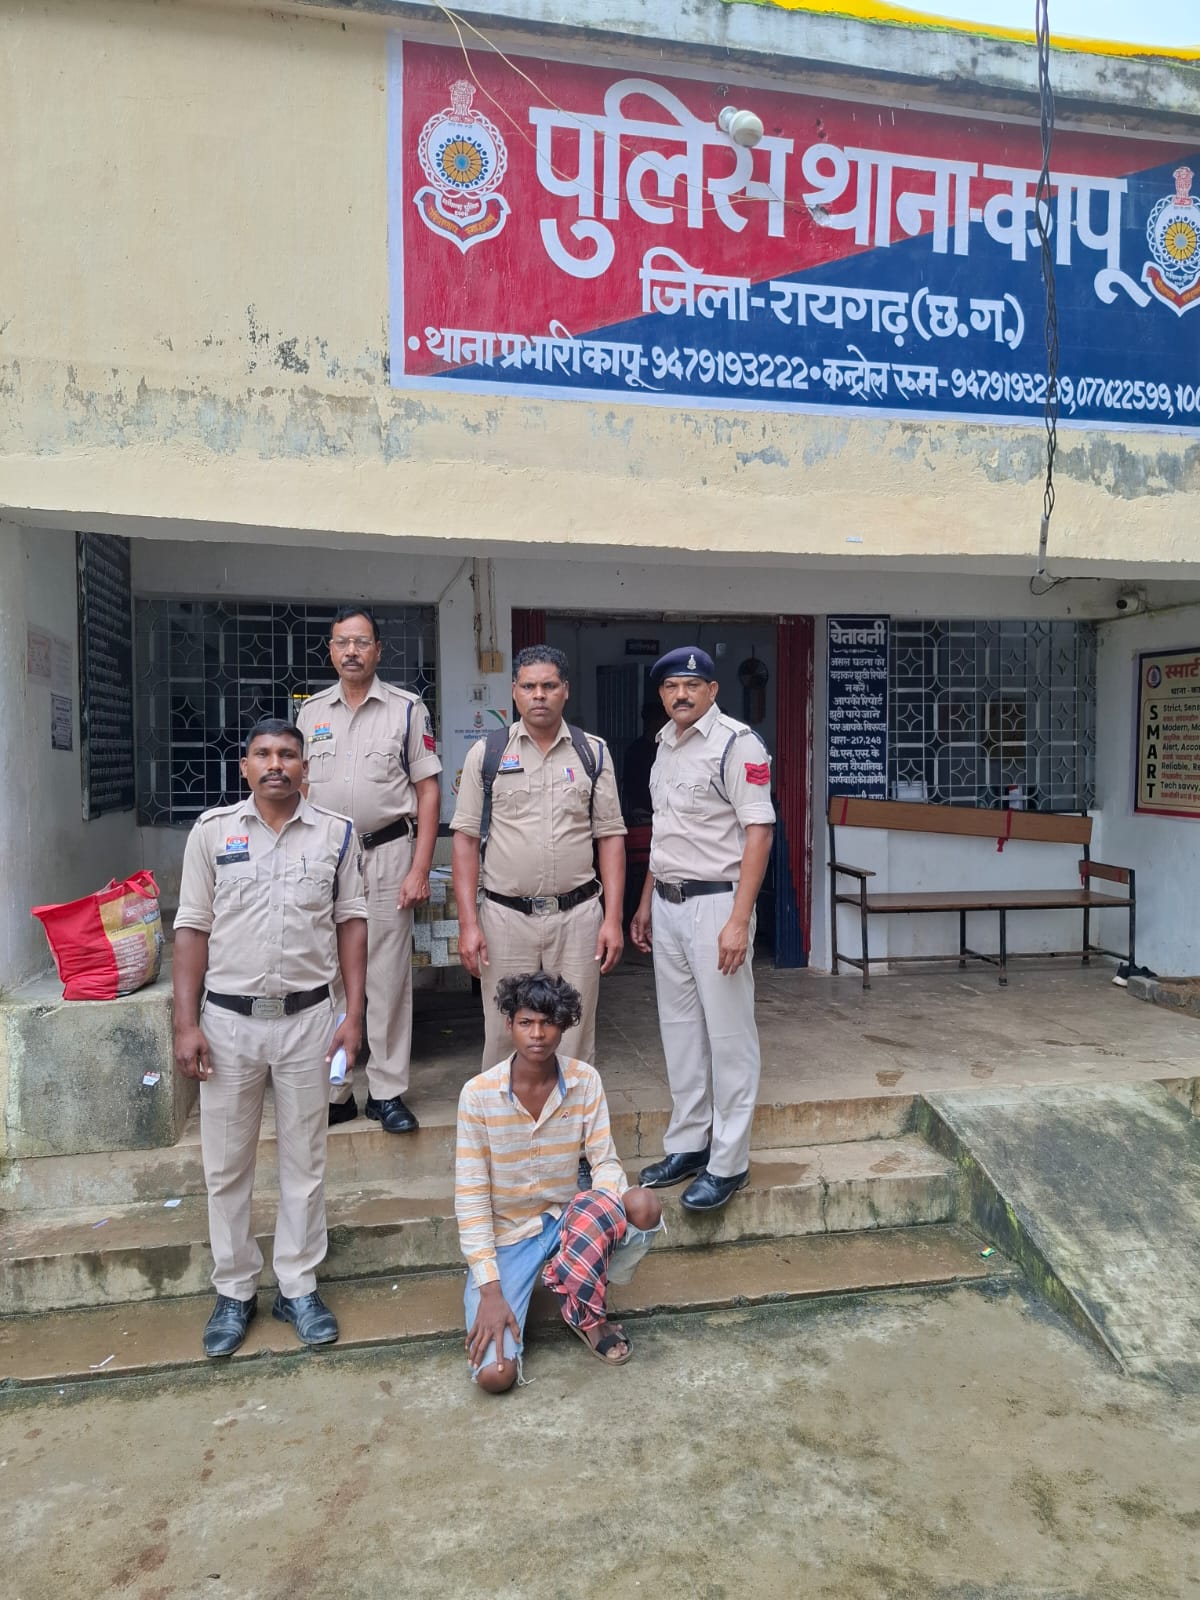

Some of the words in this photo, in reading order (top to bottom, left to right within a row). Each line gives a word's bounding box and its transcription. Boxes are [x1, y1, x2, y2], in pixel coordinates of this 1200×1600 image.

[529, 78, 794, 279] पुलिस
[423, 327, 494, 367] थाना
[496, 320, 582, 377] प्रभारी
[830, 620, 887, 645] चेतावनी
[853, 657, 873, 666] घटना
[875, 655, 885, 666] को
[845, 684, 852, 692] न
[832, 694, 860, 705] आपकी
[861, 693, 883, 706] रिपोर्ट
[845, 706, 861, 718] पाये
[861, 706, 880, 718] जाने
[829, 722, 841, 732] पर
[841, 720, 863, 732] आपके
[871, 745, 880, 757] के
[829, 762, 848, 771] तहत
[1160, 781, 1177, 789] Tech
